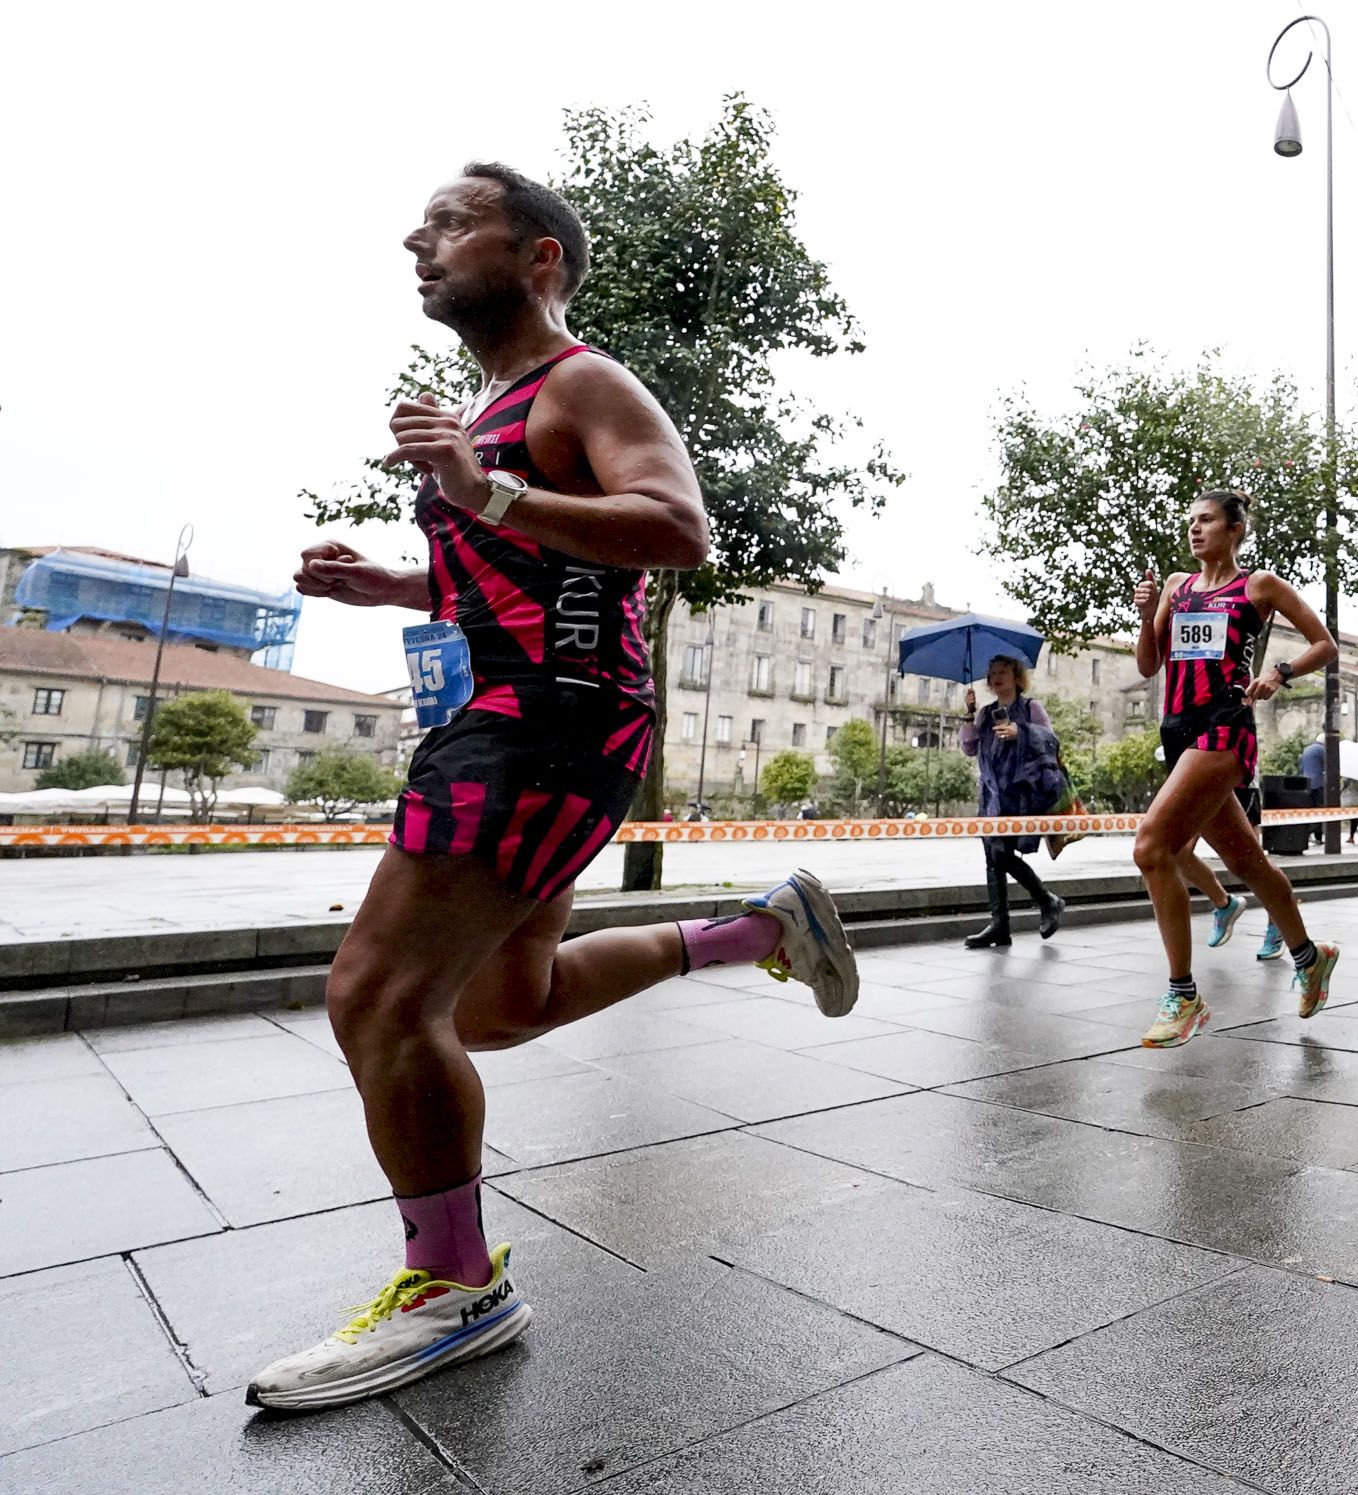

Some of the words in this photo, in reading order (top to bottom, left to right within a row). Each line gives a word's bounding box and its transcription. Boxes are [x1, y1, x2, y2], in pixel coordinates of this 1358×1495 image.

[1181, 624, 1212, 644] 589
[397, 1274, 421, 1289] OKA
[460, 1279, 514, 1327] HOKA
